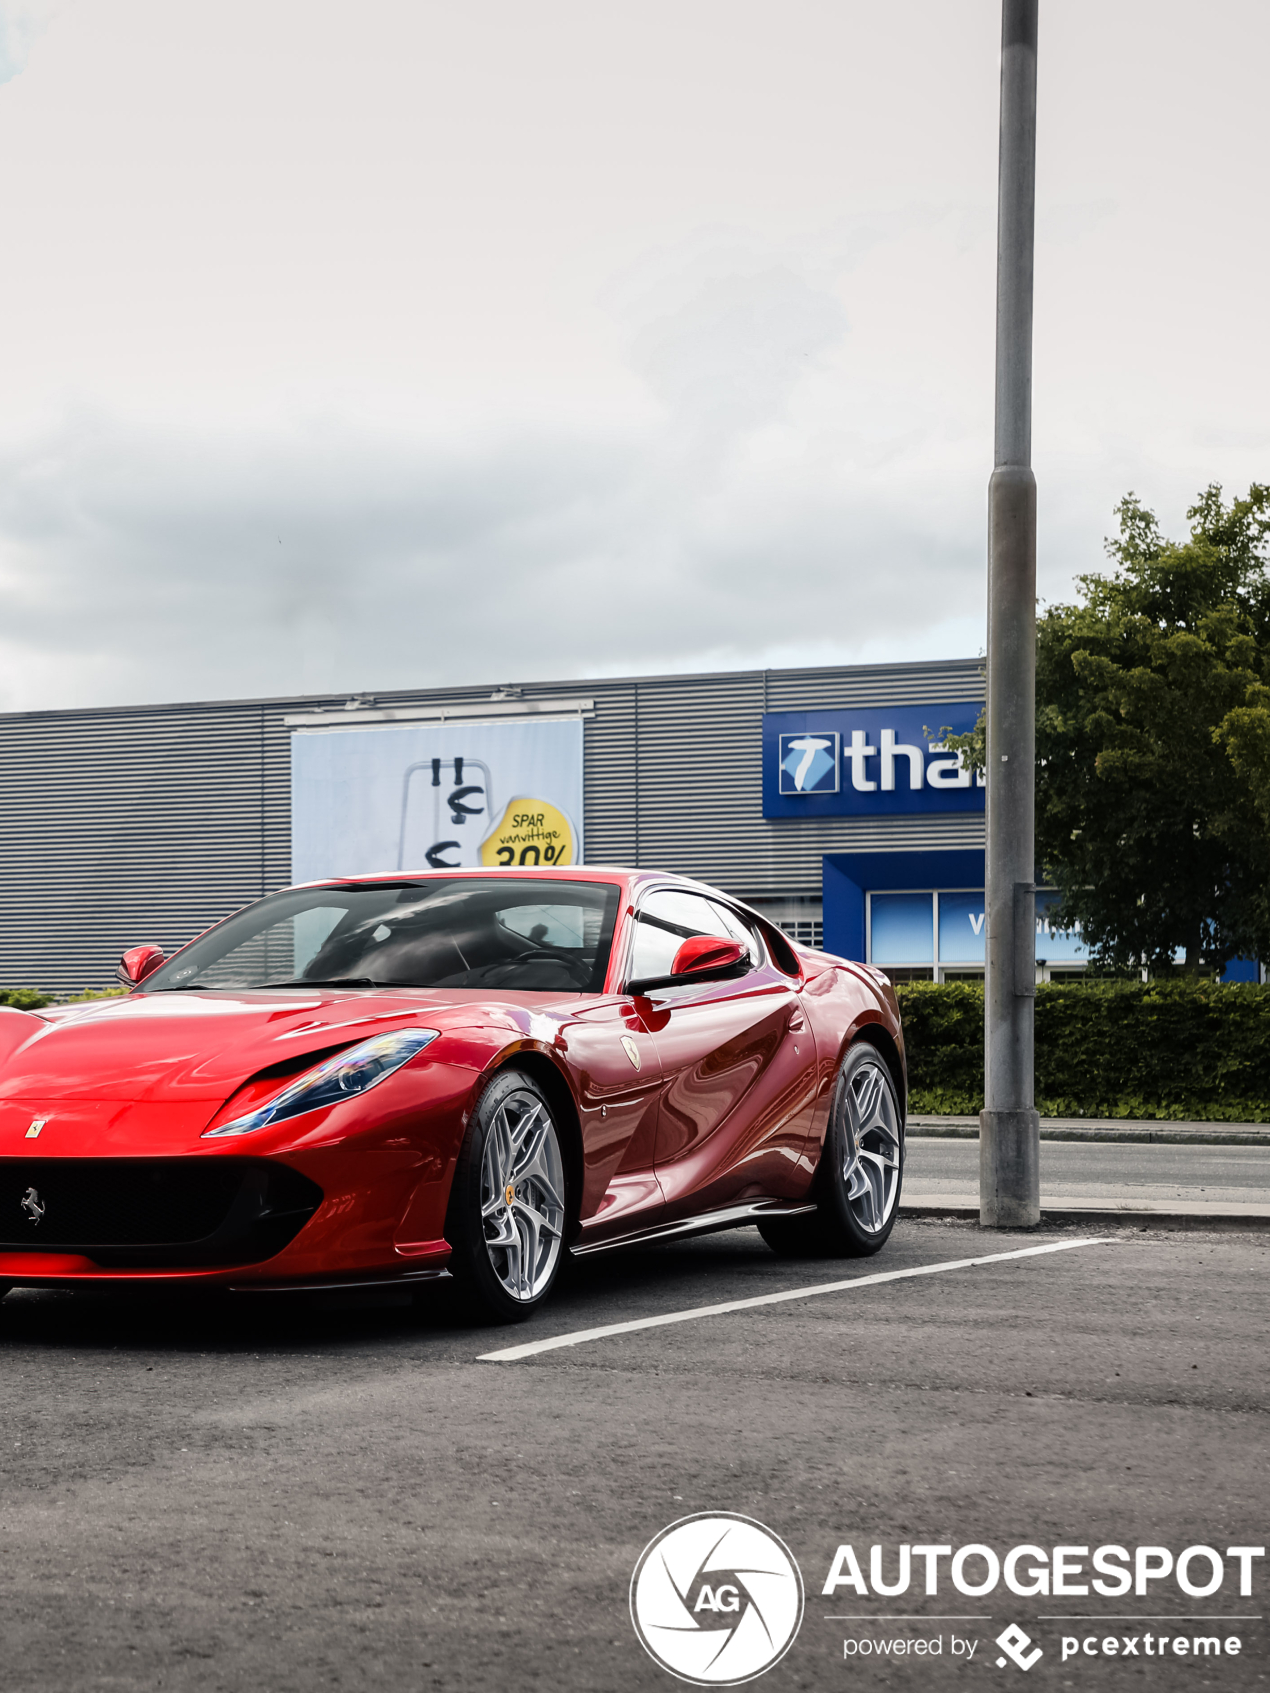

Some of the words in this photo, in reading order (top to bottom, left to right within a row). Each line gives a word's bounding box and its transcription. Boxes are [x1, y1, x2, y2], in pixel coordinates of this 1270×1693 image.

[844, 728, 986, 792] tha
[512, 813, 545, 828] SPAR
[499, 827, 561, 846] vanvittige
